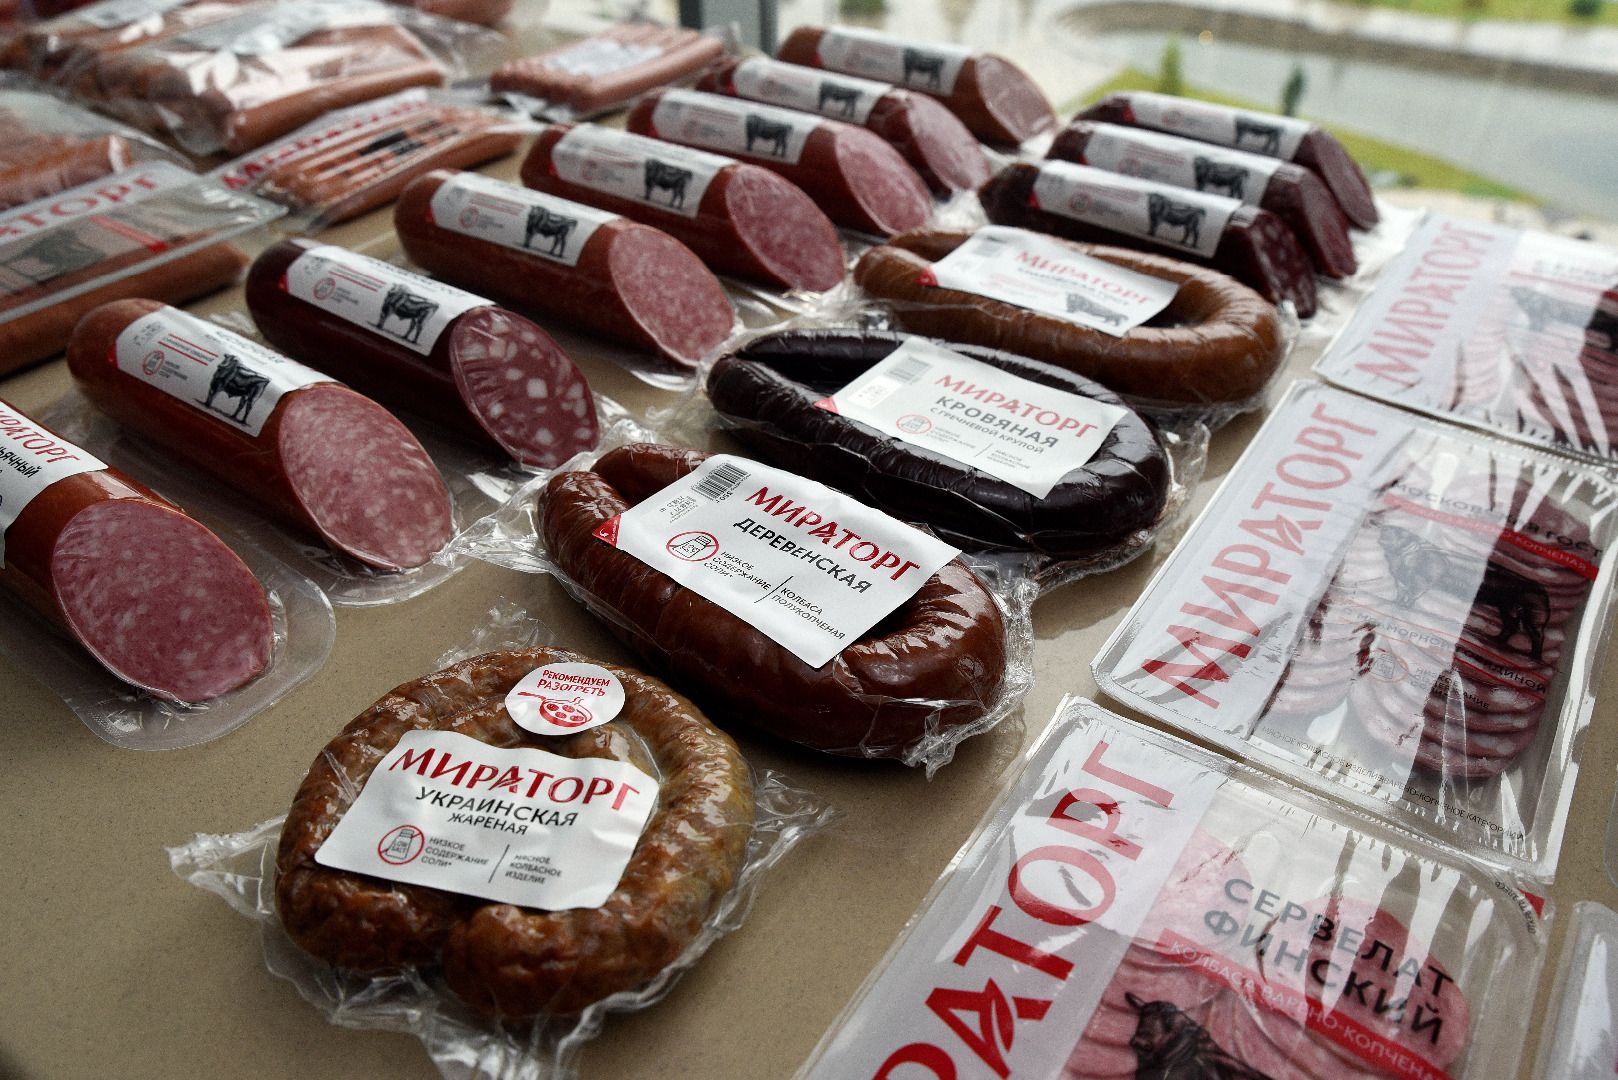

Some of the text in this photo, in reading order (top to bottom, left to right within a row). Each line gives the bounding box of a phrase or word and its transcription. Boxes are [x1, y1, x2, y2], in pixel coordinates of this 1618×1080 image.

[1015, 249, 1152, 304] МИРАТОРГ
[1353, 221, 1496, 390] МИРАТОРГ
[934, 374, 1099, 439] МИРАТОРГ
[935, 395, 1060, 448] КРОВЯНАЯ
[938, 409, 1000, 437] ГРЕЧНЕВОЙ
[999, 433, 1046, 454] КРУПОЙ
[0, 446, 43, 479] ЬЯЧНЫЙ
[744, 485, 921, 582] МИРАТОРГ
[712, 557, 772, 591] СОДЕРЖАНИЕ
[719, 551, 756, 571] НИЗКОЕ
[733, 517, 873, 594] ДЕРЕВЕНСКАЯ
[1140, 401, 1378, 711] МИРАТОРГ
[771, 594, 846, 640] ПОЛУКОПЧЕНАЯ
[780, 587, 824, 616] КОЛБАСА
[537, 678, 606, 697] РАЗОГРЕТЬ
[542, 669, 611, 687] РЕКОМЕНДУЕМ
[388, 747, 641, 811] МИРАТОРГ
[1381, 776, 1466, 818] ВАРЕНО-КОПЕНОЕ
[415, 786, 579, 828] УКРАИНСКАЯ
[447, 812, 529, 836] ЖАРЕНАЯ
[424, 846, 490, 866] СОДЕРЖАНИЕ
[428, 836, 466, 851] НИЗКОЕ
[504, 871, 546, 885] ИЗДЕЛИЕ
[510, 861, 563, 878] КОЛБАСНОЕ
[1223, 878, 1455, 998] СЕРВЕЛАТ
[1172, 940, 1256, 996] КОЛБАСА
[1203, 910, 1444, 1045] ФИНСКИЙ
